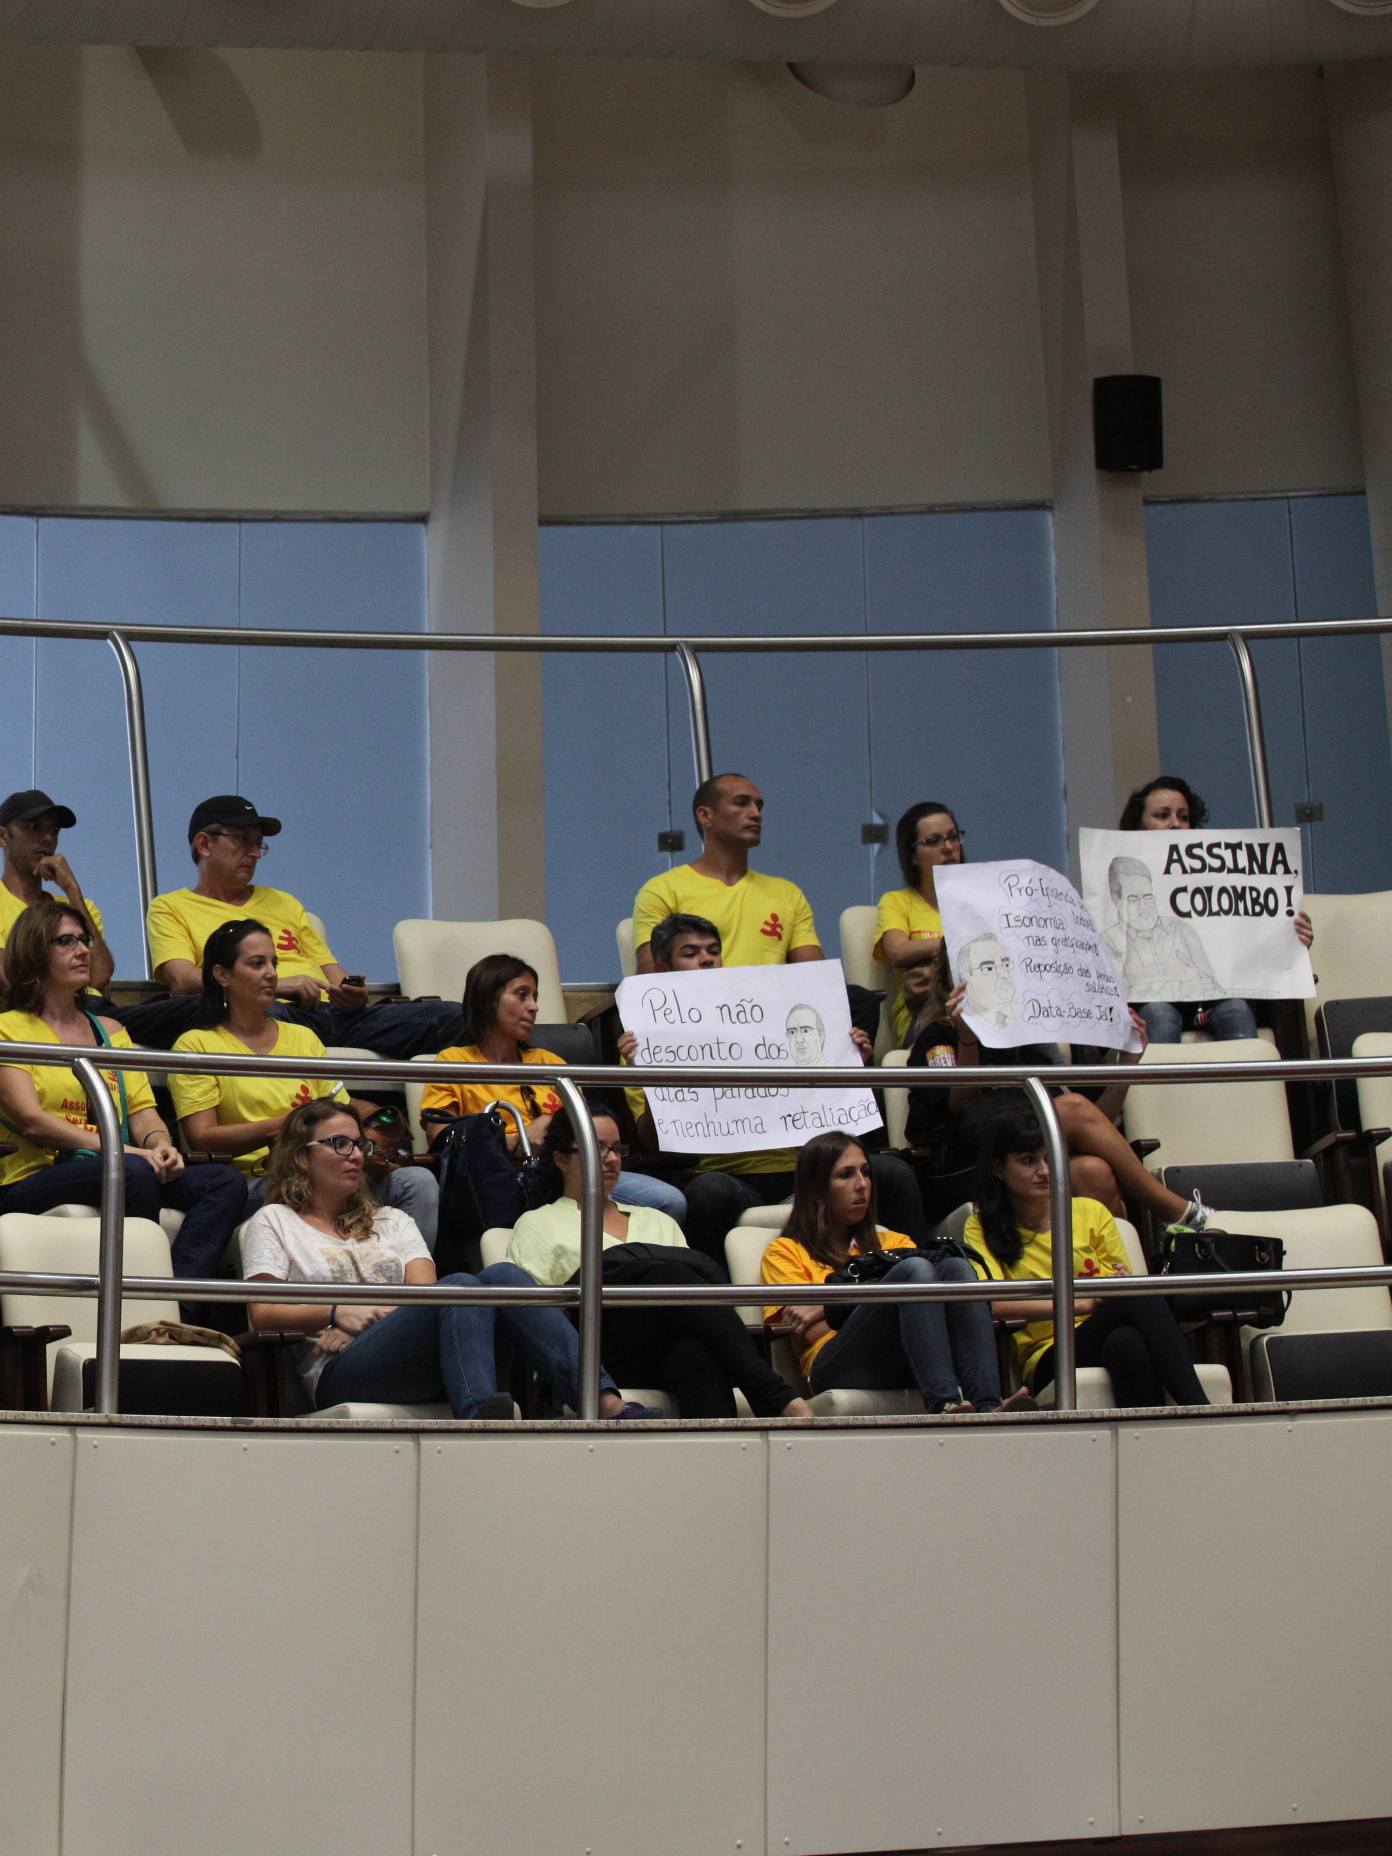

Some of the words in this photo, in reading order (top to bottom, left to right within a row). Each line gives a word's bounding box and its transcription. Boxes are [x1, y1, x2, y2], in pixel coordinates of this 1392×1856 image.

[1163, 841, 1299, 878] ASSINA,
[1002, 912, 1066, 932] Isonomia
[1024, 935, 1048, 947] nas
[1021, 957, 1074, 981] Reposição
[1077, 962, 1092, 978] das
[642, 988, 702, 1024] Pelo
[715, 998, 764, 1024] não
[640, 1037, 743, 1065] desconto
[754, 1036, 789, 1060] dos
[658, 1117, 669, 1135] e
[670, 1112, 768, 1138] nenhuma
[779, 1097, 879, 1132] retaliação
